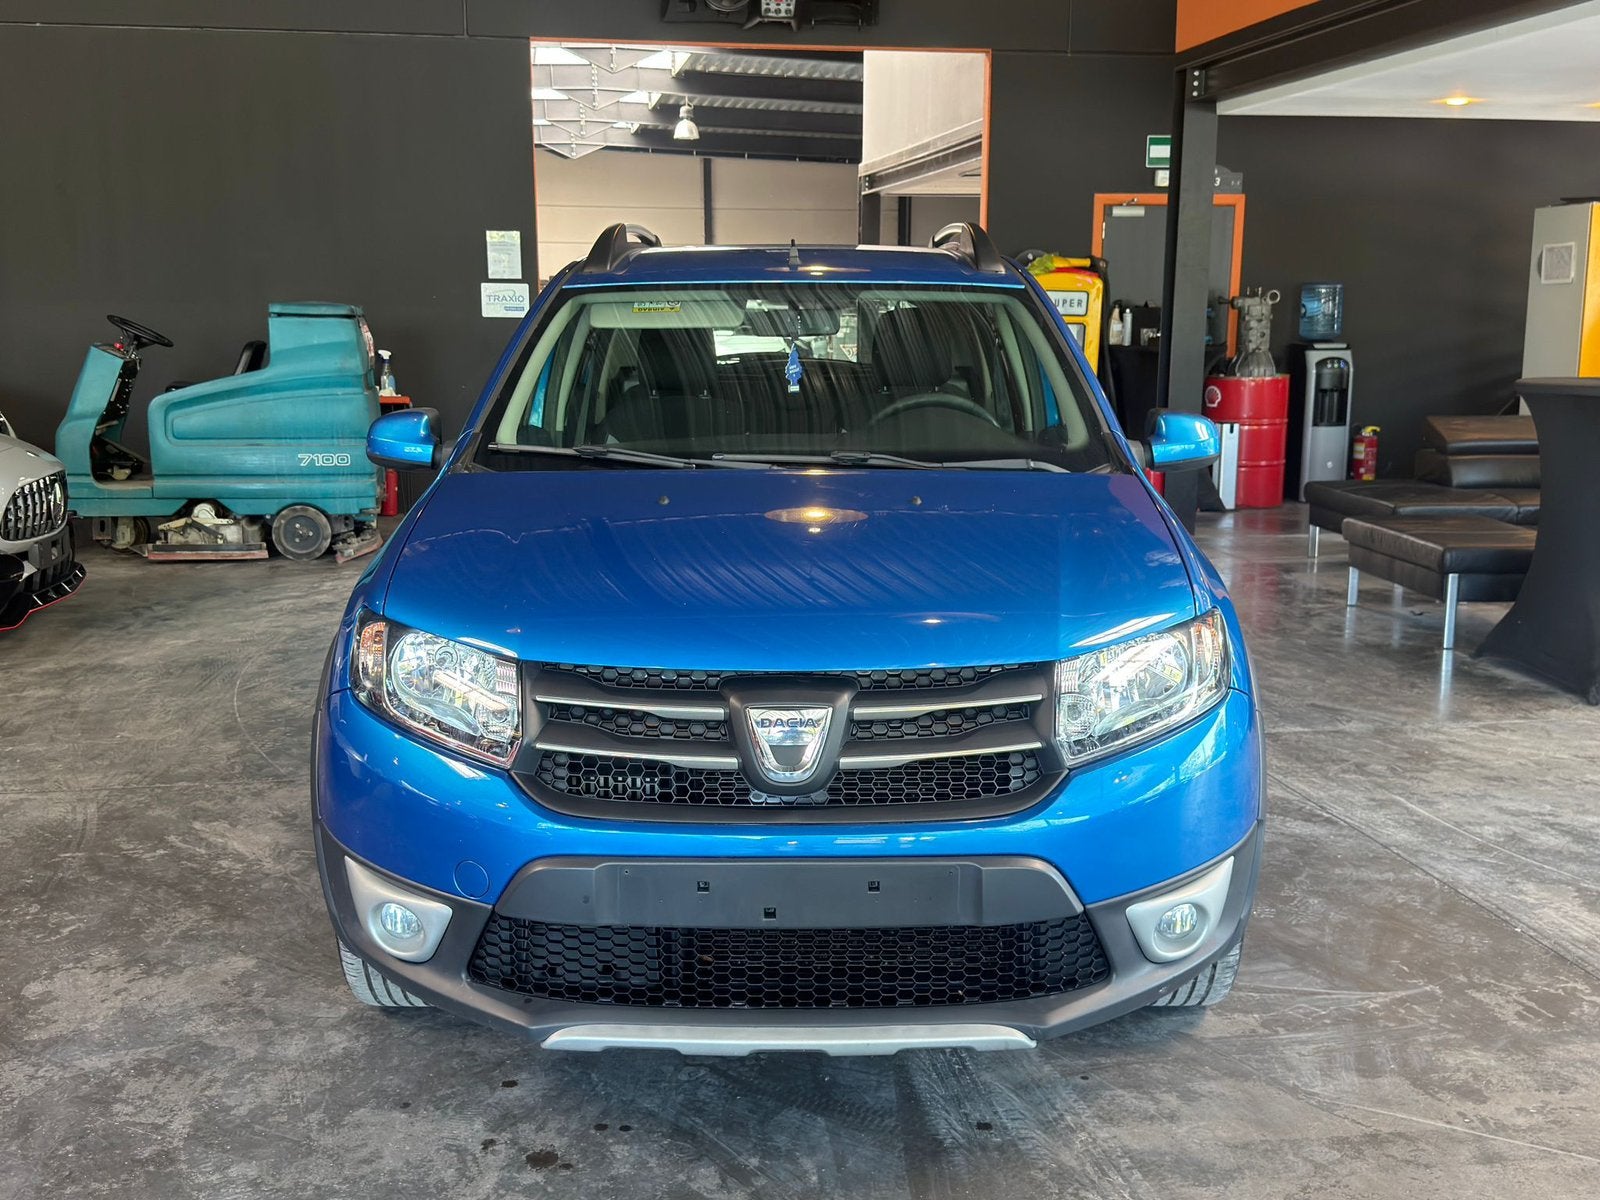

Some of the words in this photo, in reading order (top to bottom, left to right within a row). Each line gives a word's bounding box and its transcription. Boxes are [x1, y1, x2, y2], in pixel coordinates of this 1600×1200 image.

[486, 294, 525, 303] TRAXIO
[1054, 298, 1083, 308] UPER
[298, 453, 351, 467] 7100
[760, 718, 817, 728] DACIA
